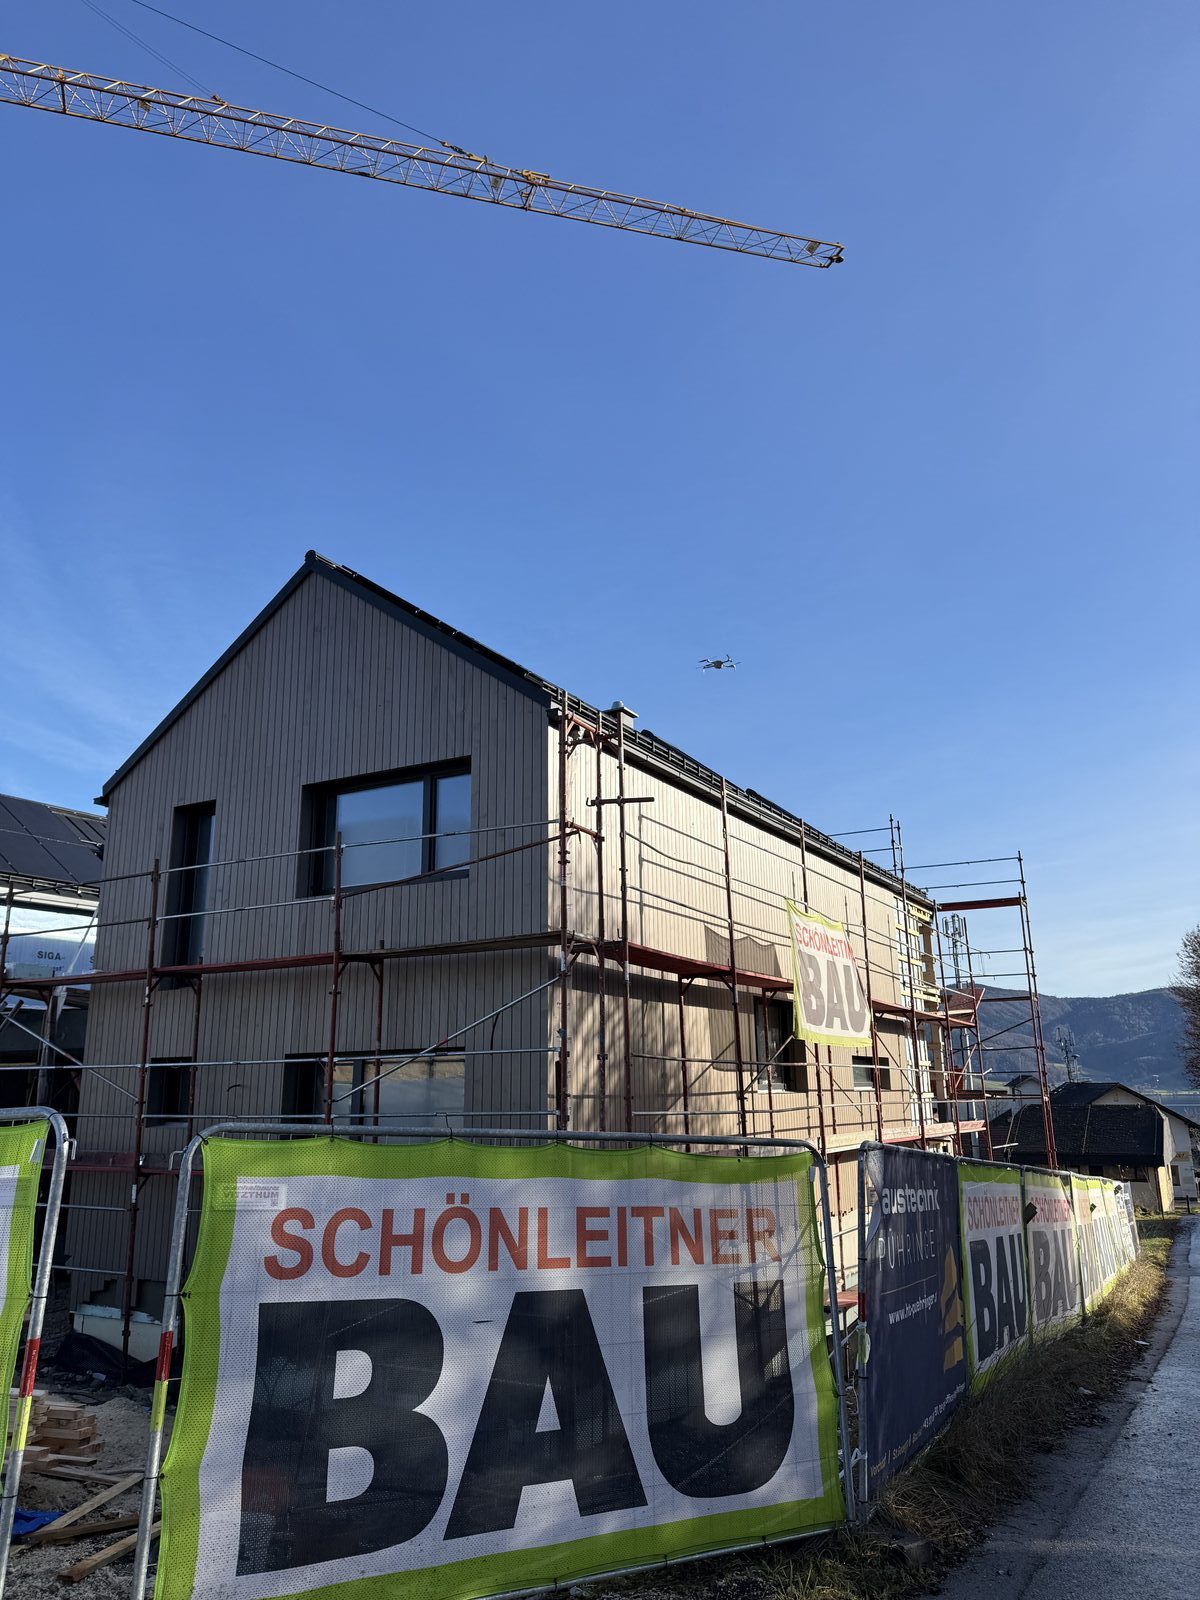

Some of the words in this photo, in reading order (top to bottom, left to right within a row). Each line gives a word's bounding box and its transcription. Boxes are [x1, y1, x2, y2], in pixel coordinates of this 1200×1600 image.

[795, 922, 855, 962] SCHÖNLEITN
[800, 951, 867, 1033] BAU
[264, 1193, 781, 1281] SCHÖNLEITNER
[878, 1227, 937, 1272] PÜHRINGE
[1031, 1229, 1078, 1322] BAU
[969, 1232, 1027, 1364] BAU
[236, 1280, 796, 1576] BAU
